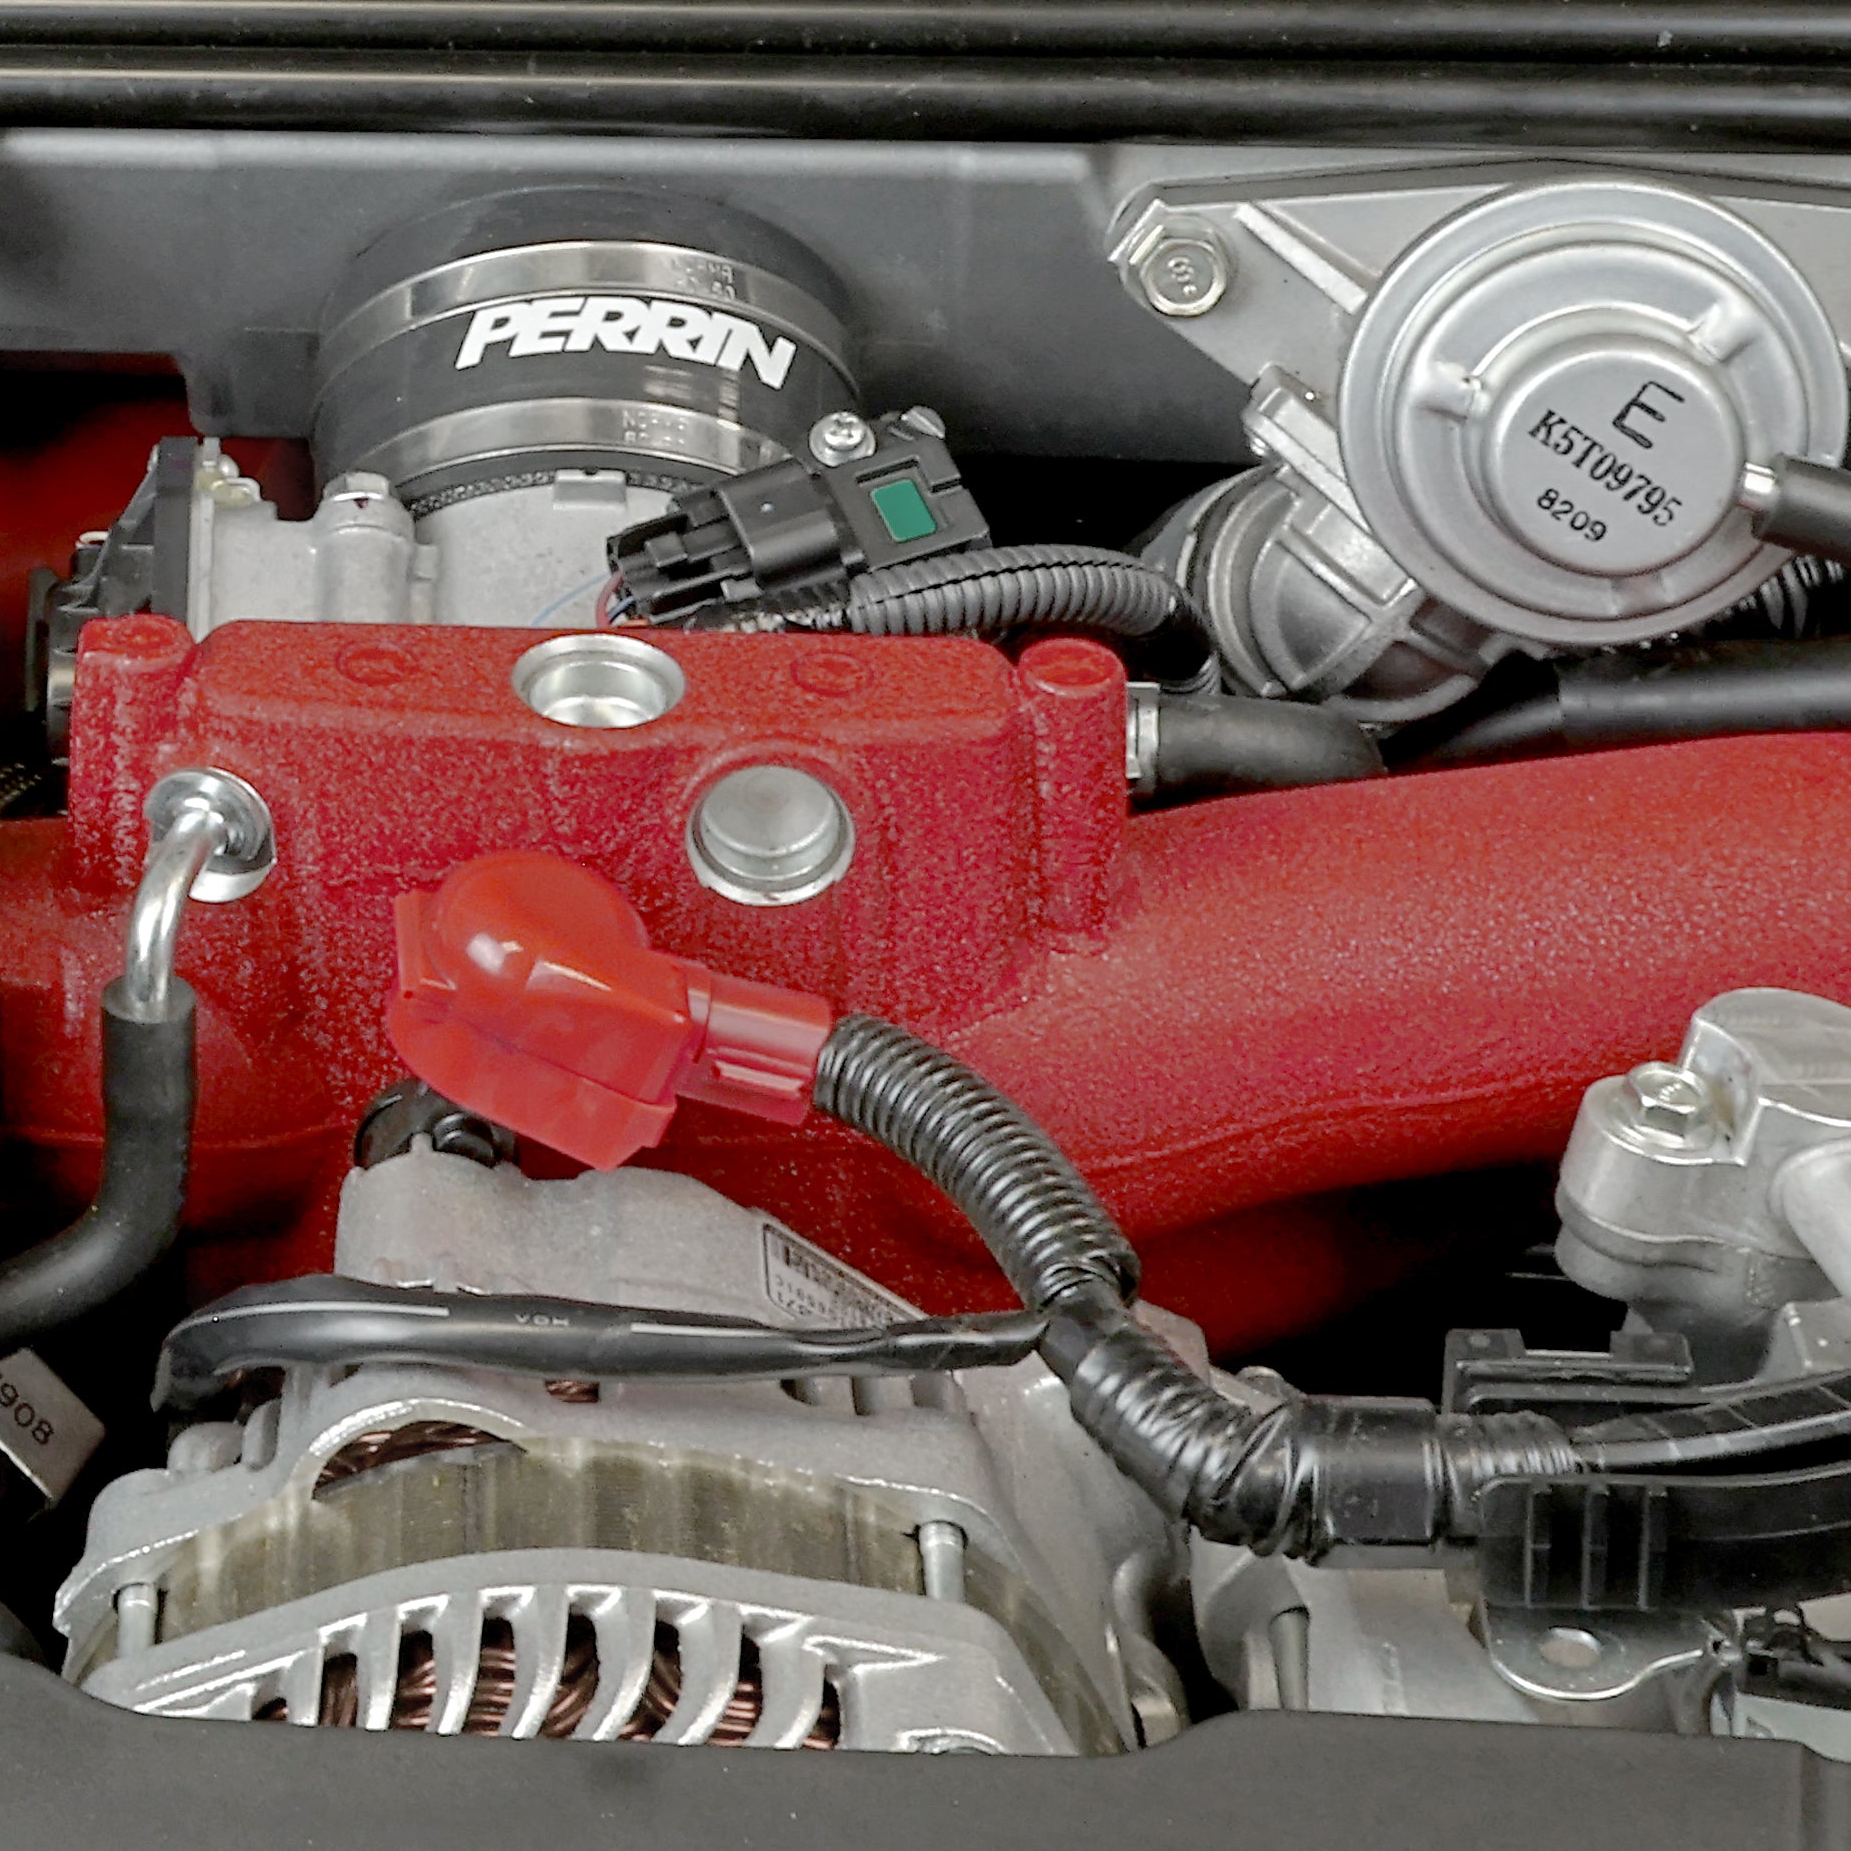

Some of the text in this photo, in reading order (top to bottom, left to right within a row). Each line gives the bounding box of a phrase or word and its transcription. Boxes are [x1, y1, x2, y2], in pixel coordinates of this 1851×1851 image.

[454, 296, 797, 390] PERRIN
[1612, 380, 1685, 450] E
[1528, 408, 1684, 528] K5T09795
[1536, 488, 1608, 543] 8209
